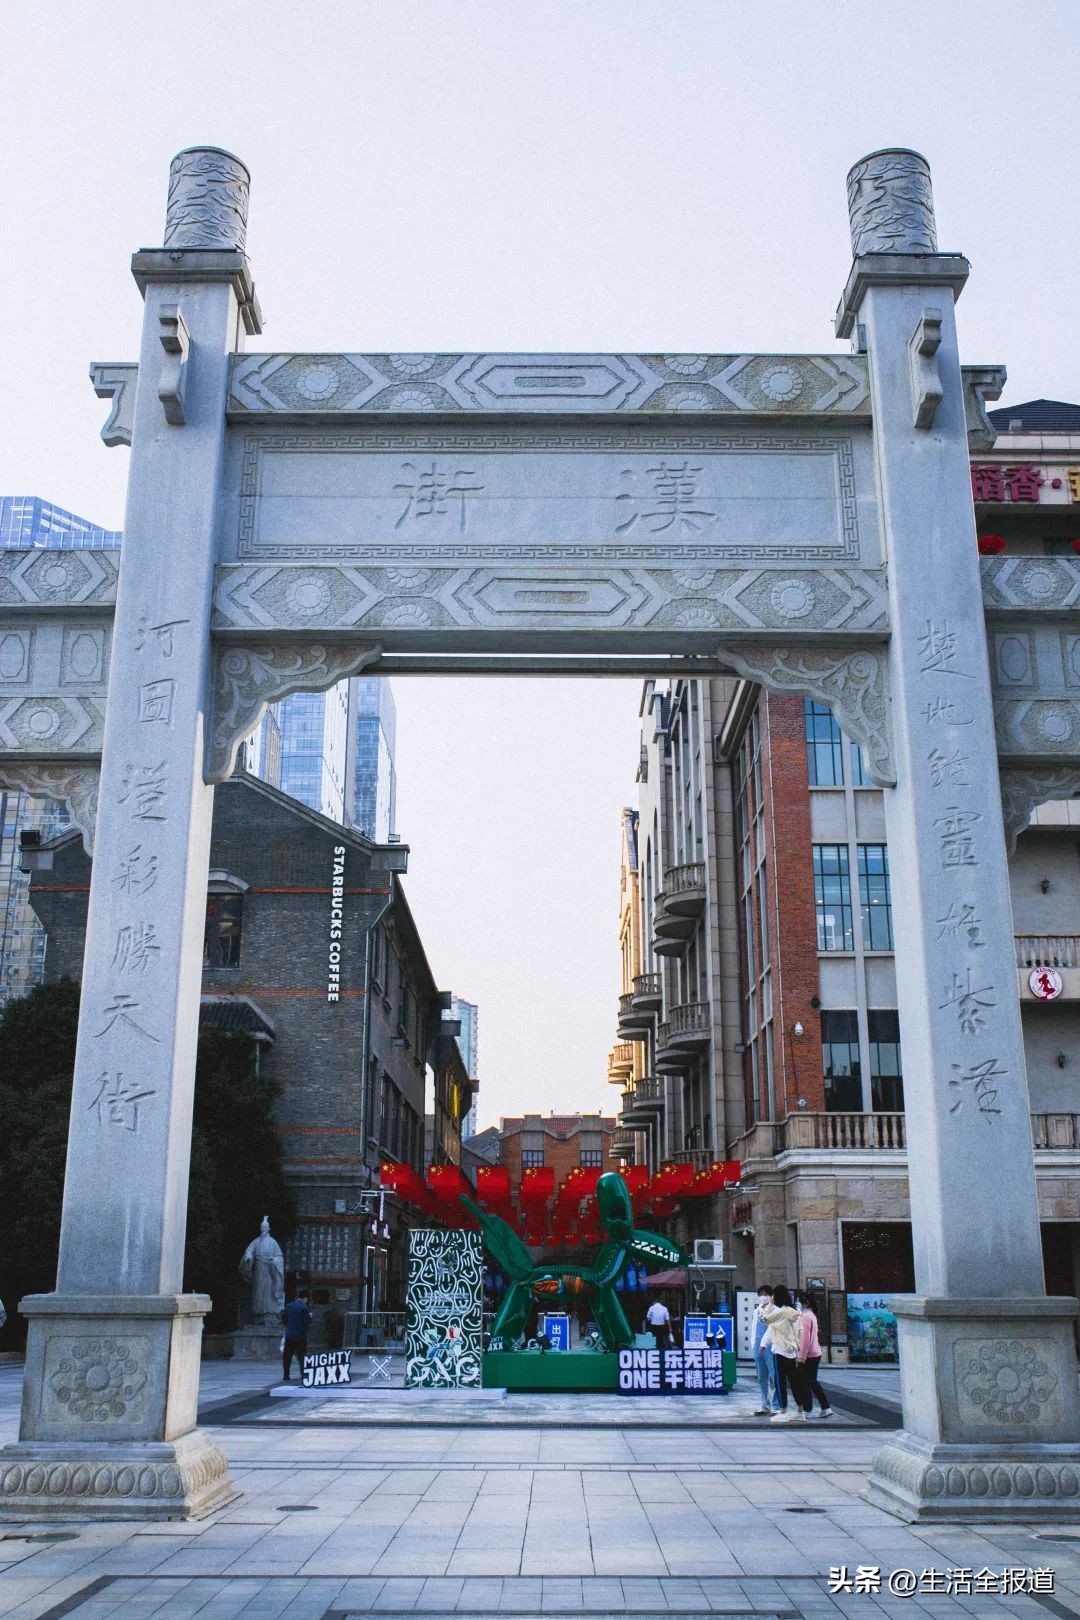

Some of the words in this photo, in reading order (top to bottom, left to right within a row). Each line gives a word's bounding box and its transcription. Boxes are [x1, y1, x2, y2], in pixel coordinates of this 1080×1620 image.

[330, 846, 346, 939] STARBUCKS
[327, 942, 341, 1002] COFFEE
[303, 1350, 351, 1368] MIGHTY
[619, 1350, 660, 1369] ONE
[664, 1350, 723, 1369] 乐无限
[303, 1363, 351, 1387] JAXX
[619, 1369, 661, 1389] ONE
